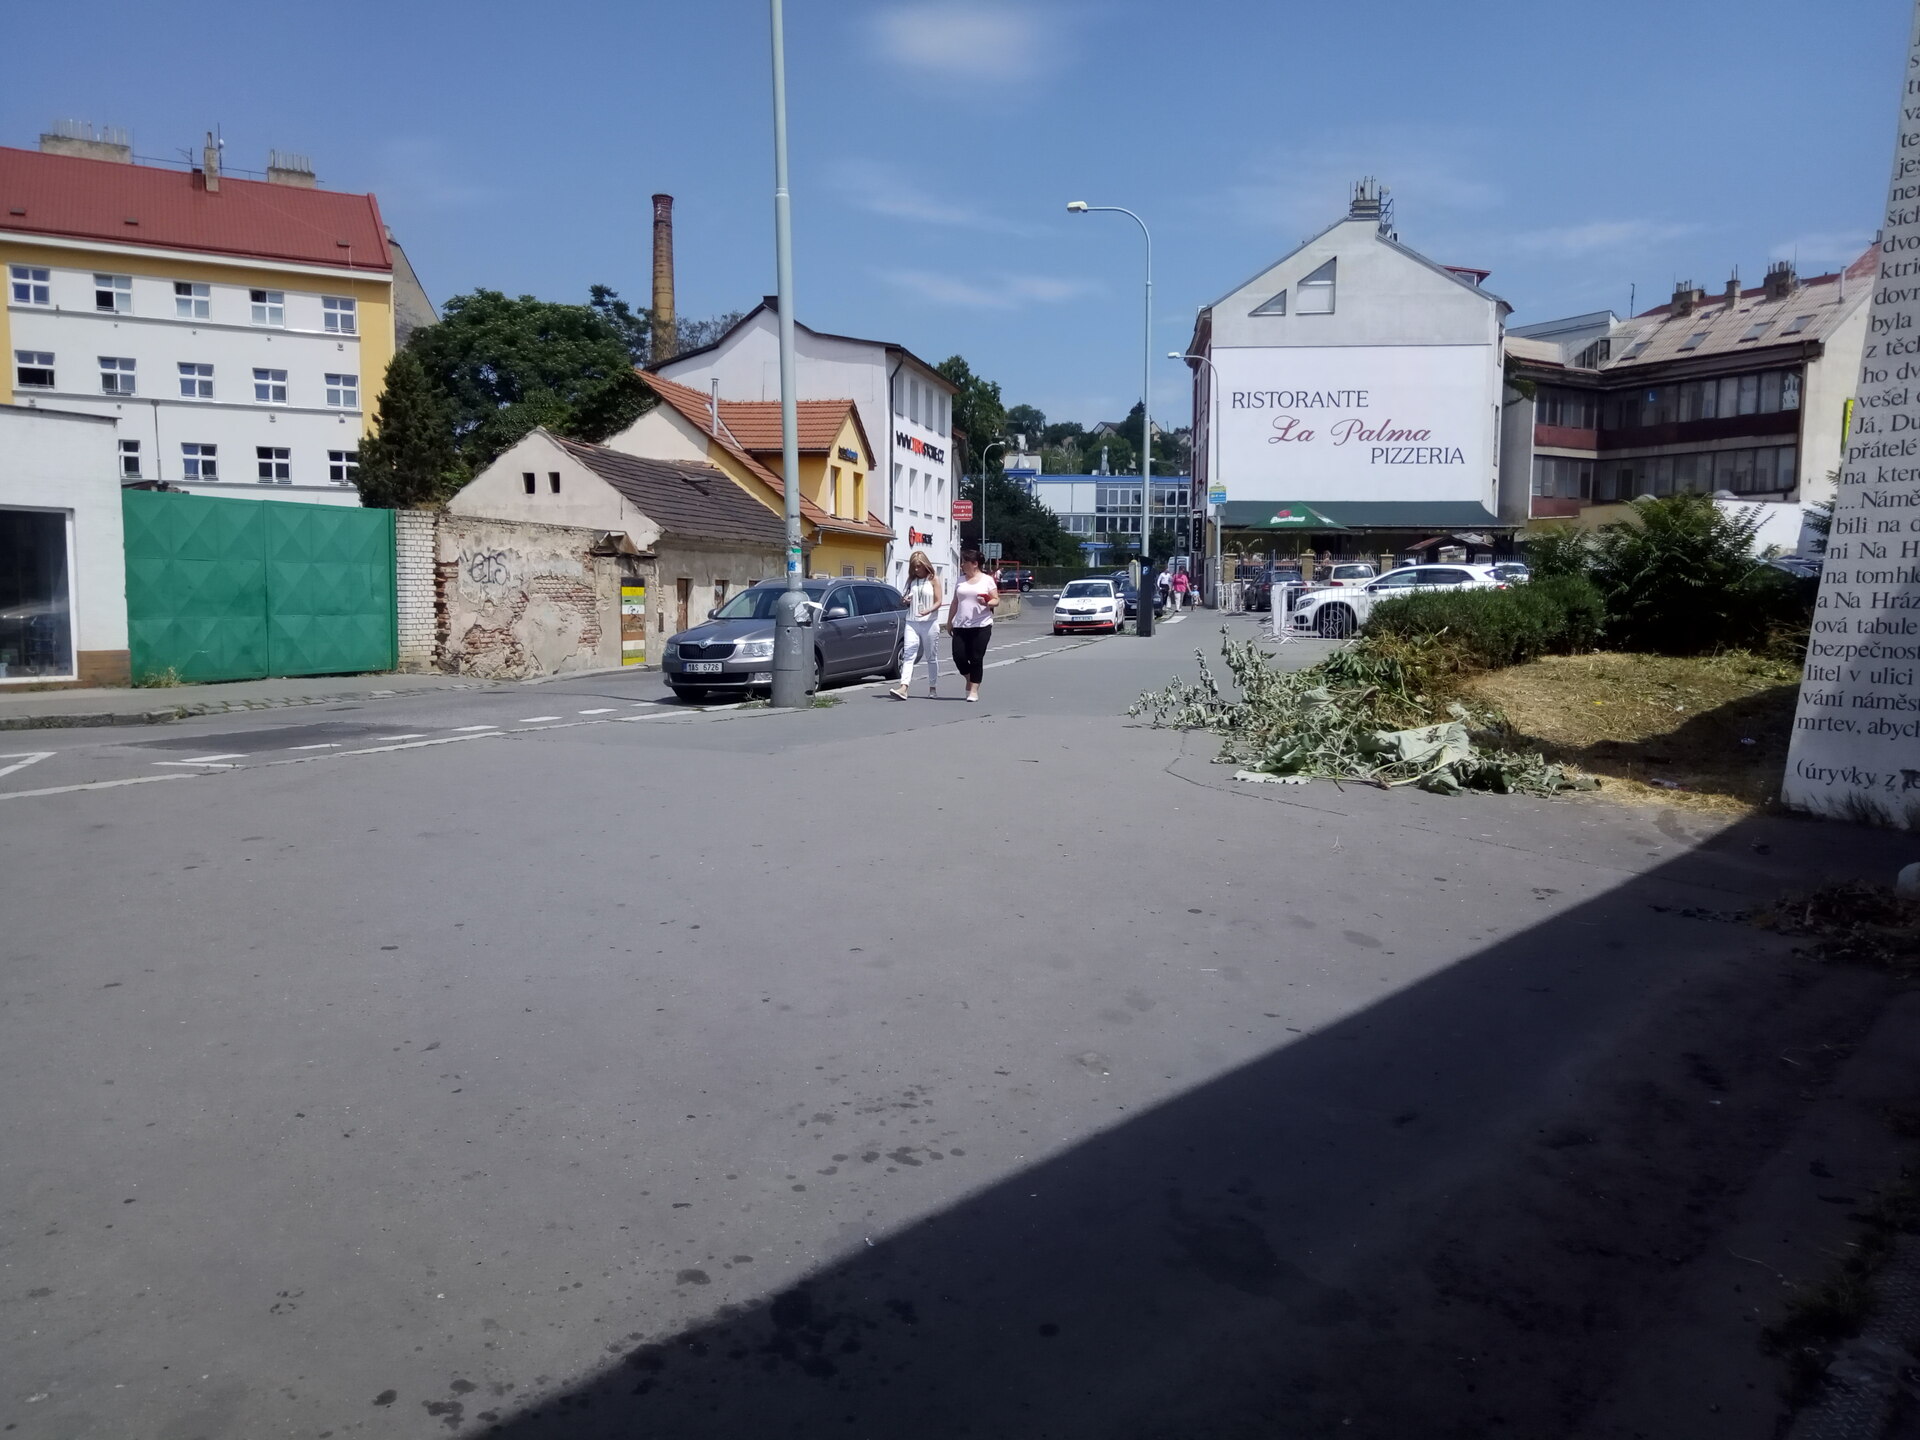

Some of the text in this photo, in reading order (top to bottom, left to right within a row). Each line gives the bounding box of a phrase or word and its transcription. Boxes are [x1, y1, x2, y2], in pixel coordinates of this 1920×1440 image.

[1892, 185, 1920, 201] ne
[1887, 205, 1920, 227] šíc
[1880, 258, 1920, 280] ktri
[1871, 312, 1913, 336] byla
[1866, 335, 1920, 358] z těc
[1862, 366, 1888, 384] ho
[1231, 390, 1369, 409] RISTORANTE
[1858, 387, 1909, 408] vešel
[1267, 415, 1432, 446] La Palma
[1370, 447, 1466, 464] PIZZERIA
[1848, 438, 1918, 465] přátelé
[1844, 471, 1866, 485] na
[1836, 516, 1868, 535] bili
[1877, 519, 1901, 533] na
[1830, 542, 1848, 559] ni
[1858, 541, 1887, 559] Na
[1825, 571, 1848, 584] na
[1817, 591, 1920, 609] a Na Hráz
[1814, 616, 1918, 635] ová tabule
[1806, 664, 1913, 686] litel v ulici
[1803, 689, 1844, 708] vání
[1797, 715, 1861, 735] mrtev,
[1884, 773, 1897, 788] z
